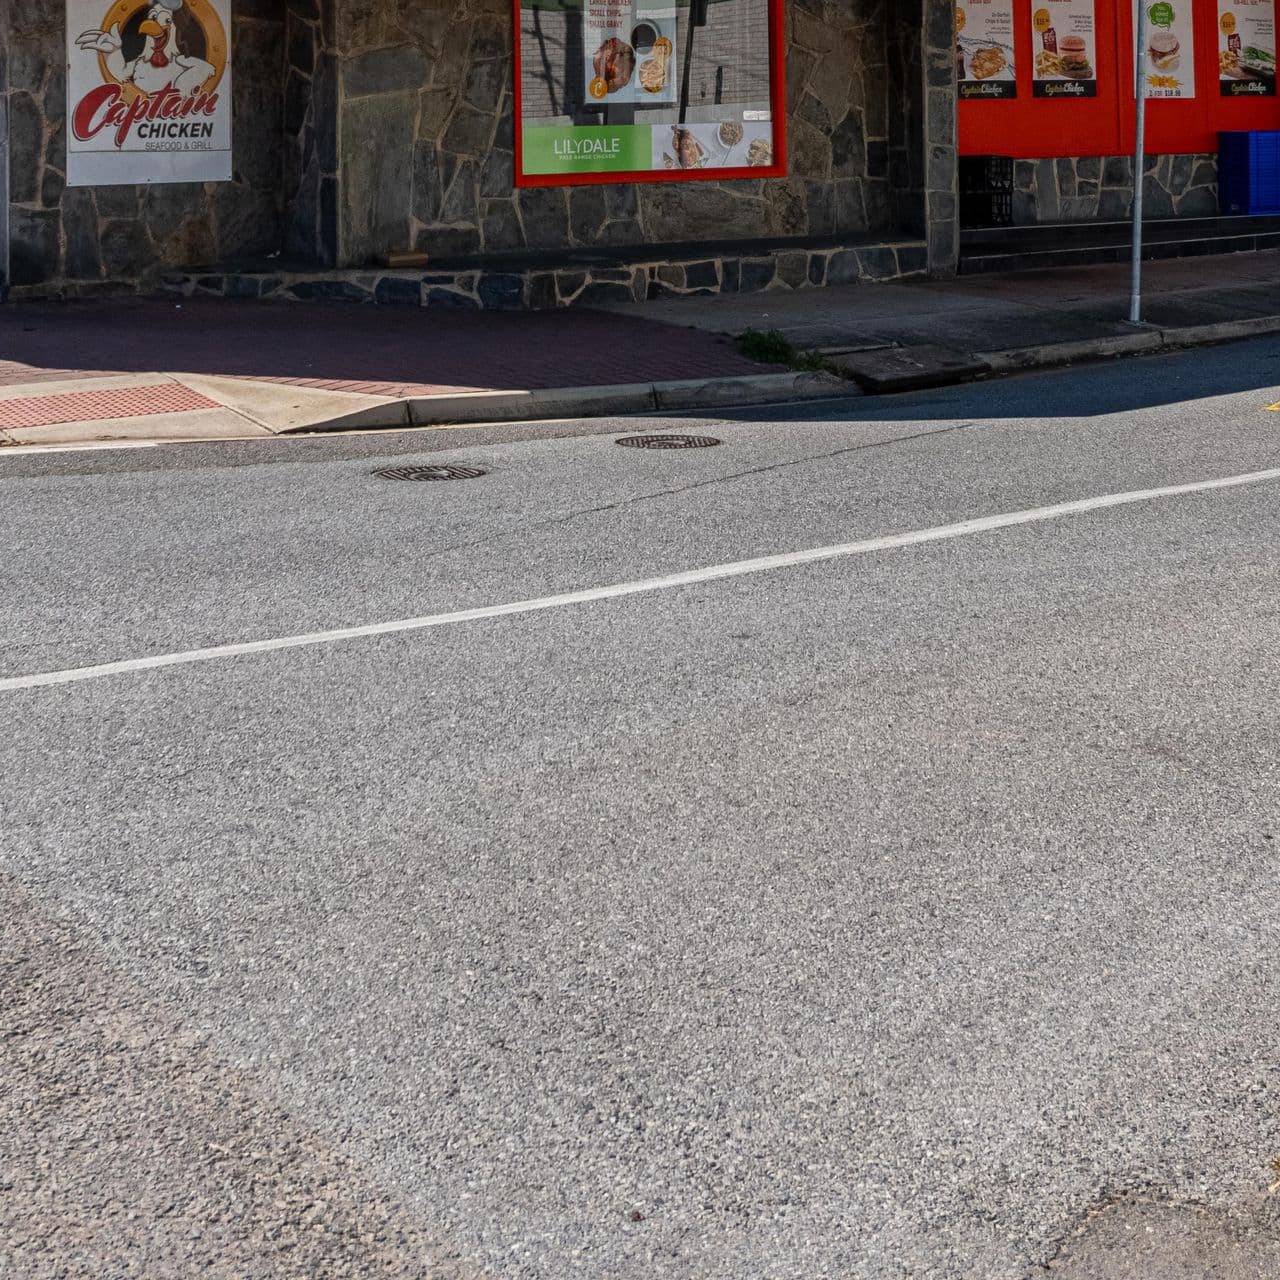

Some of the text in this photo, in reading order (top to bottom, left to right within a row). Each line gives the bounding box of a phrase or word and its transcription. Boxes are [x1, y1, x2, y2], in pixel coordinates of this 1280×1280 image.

[72, 81, 220, 147] Captain
[137, 122, 214, 139] CHICKEN
[145, 141, 214, 151] SEAFOOD & GRILL
[554, 138, 620, 154] LILYDALE
